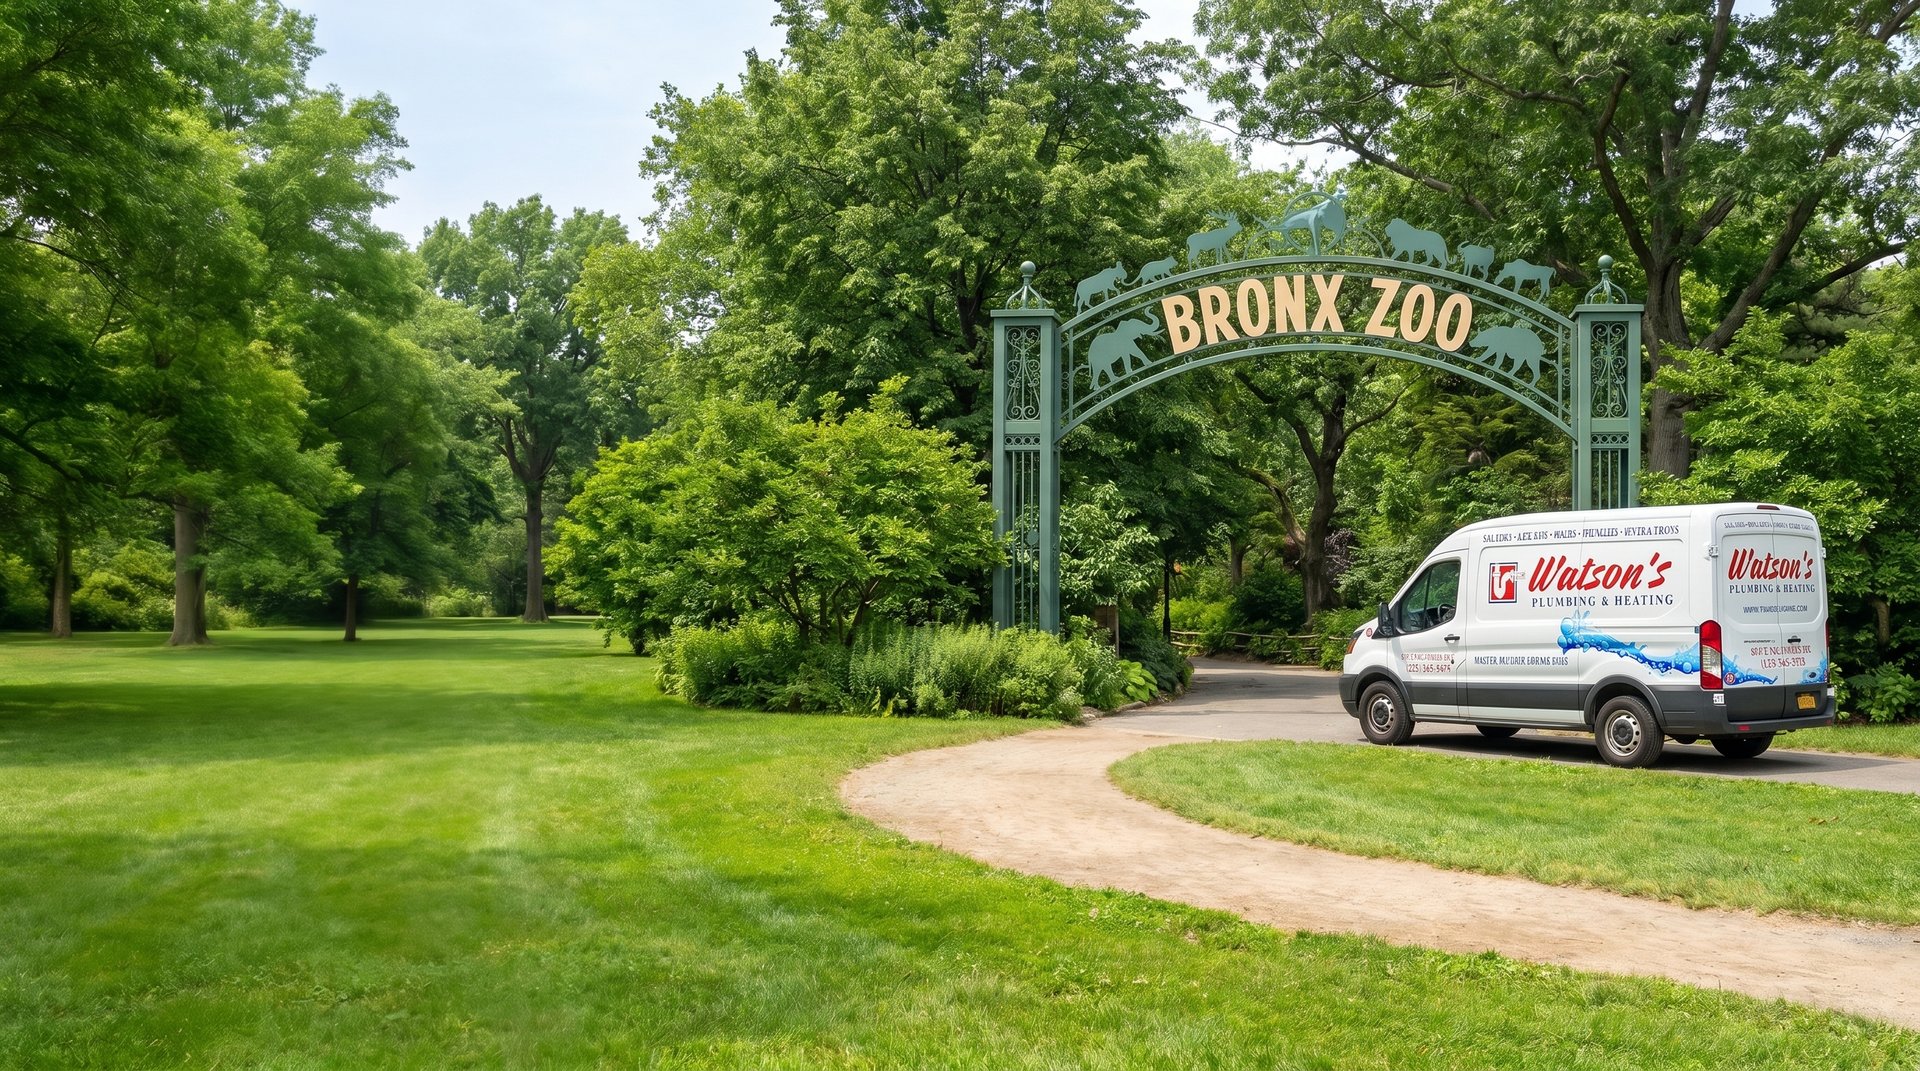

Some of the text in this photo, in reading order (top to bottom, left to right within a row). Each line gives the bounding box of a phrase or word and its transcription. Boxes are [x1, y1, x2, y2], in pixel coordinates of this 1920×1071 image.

[1161, 274, 1473, 355] BRONX ZOO
[1528, 552, 1672, 592] Watson's
[1728, 548, 1814, 580] Watson's
[1532, 594, 1674, 607] PLUMBING & HEATING
[1729, 584, 1774, 594] PLUMBING
[1783, 584, 1816, 593] HEATING
